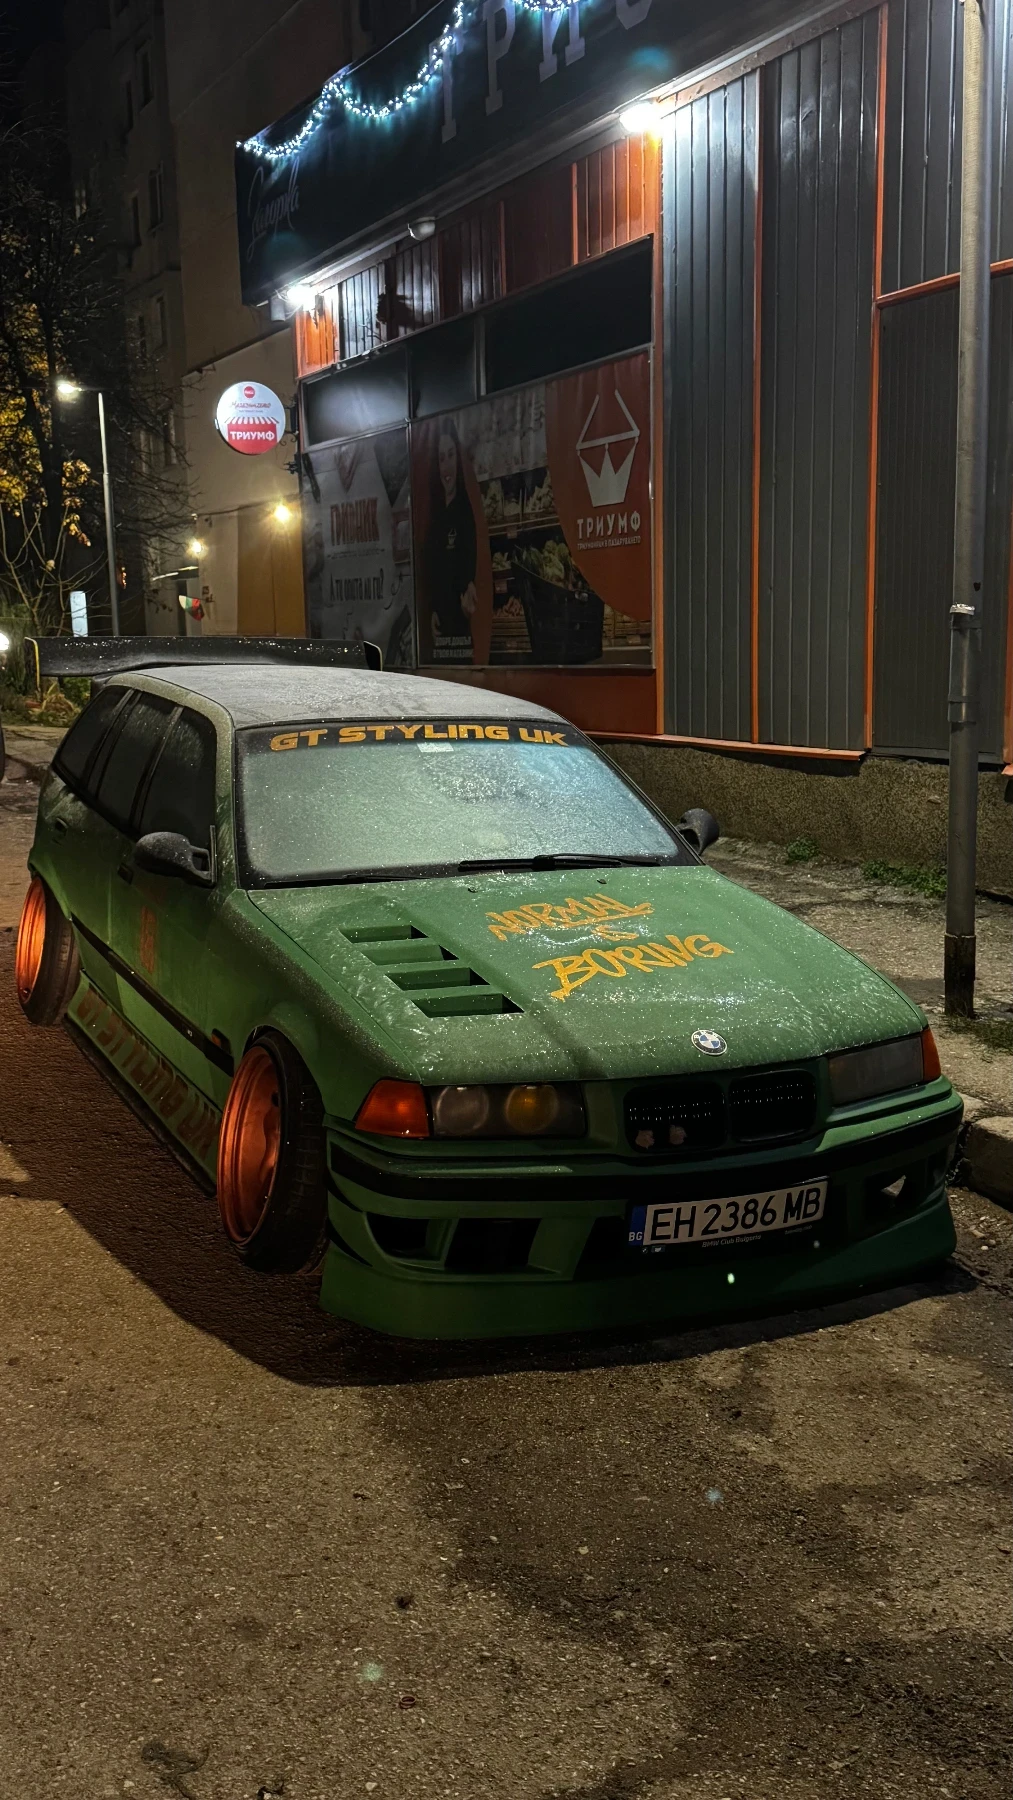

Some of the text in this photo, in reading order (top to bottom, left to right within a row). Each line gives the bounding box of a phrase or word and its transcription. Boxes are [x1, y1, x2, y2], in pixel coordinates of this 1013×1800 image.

[229, 431, 275, 441] ТРИУМФ
[576, 510, 641, 540] ТРИУМФ
[269, 724, 570, 751] GT STYLING UK
[485, 893, 655, 941] NORMAL
[532, 934, 735, 1002] BORING
[650, 1187, 822, 1241] EH 2386 MB
[628, 1231, 643, 1242] BG
[701, 1239, 720, 1248] BMW
[720, 1237, 735, 1246] Club
